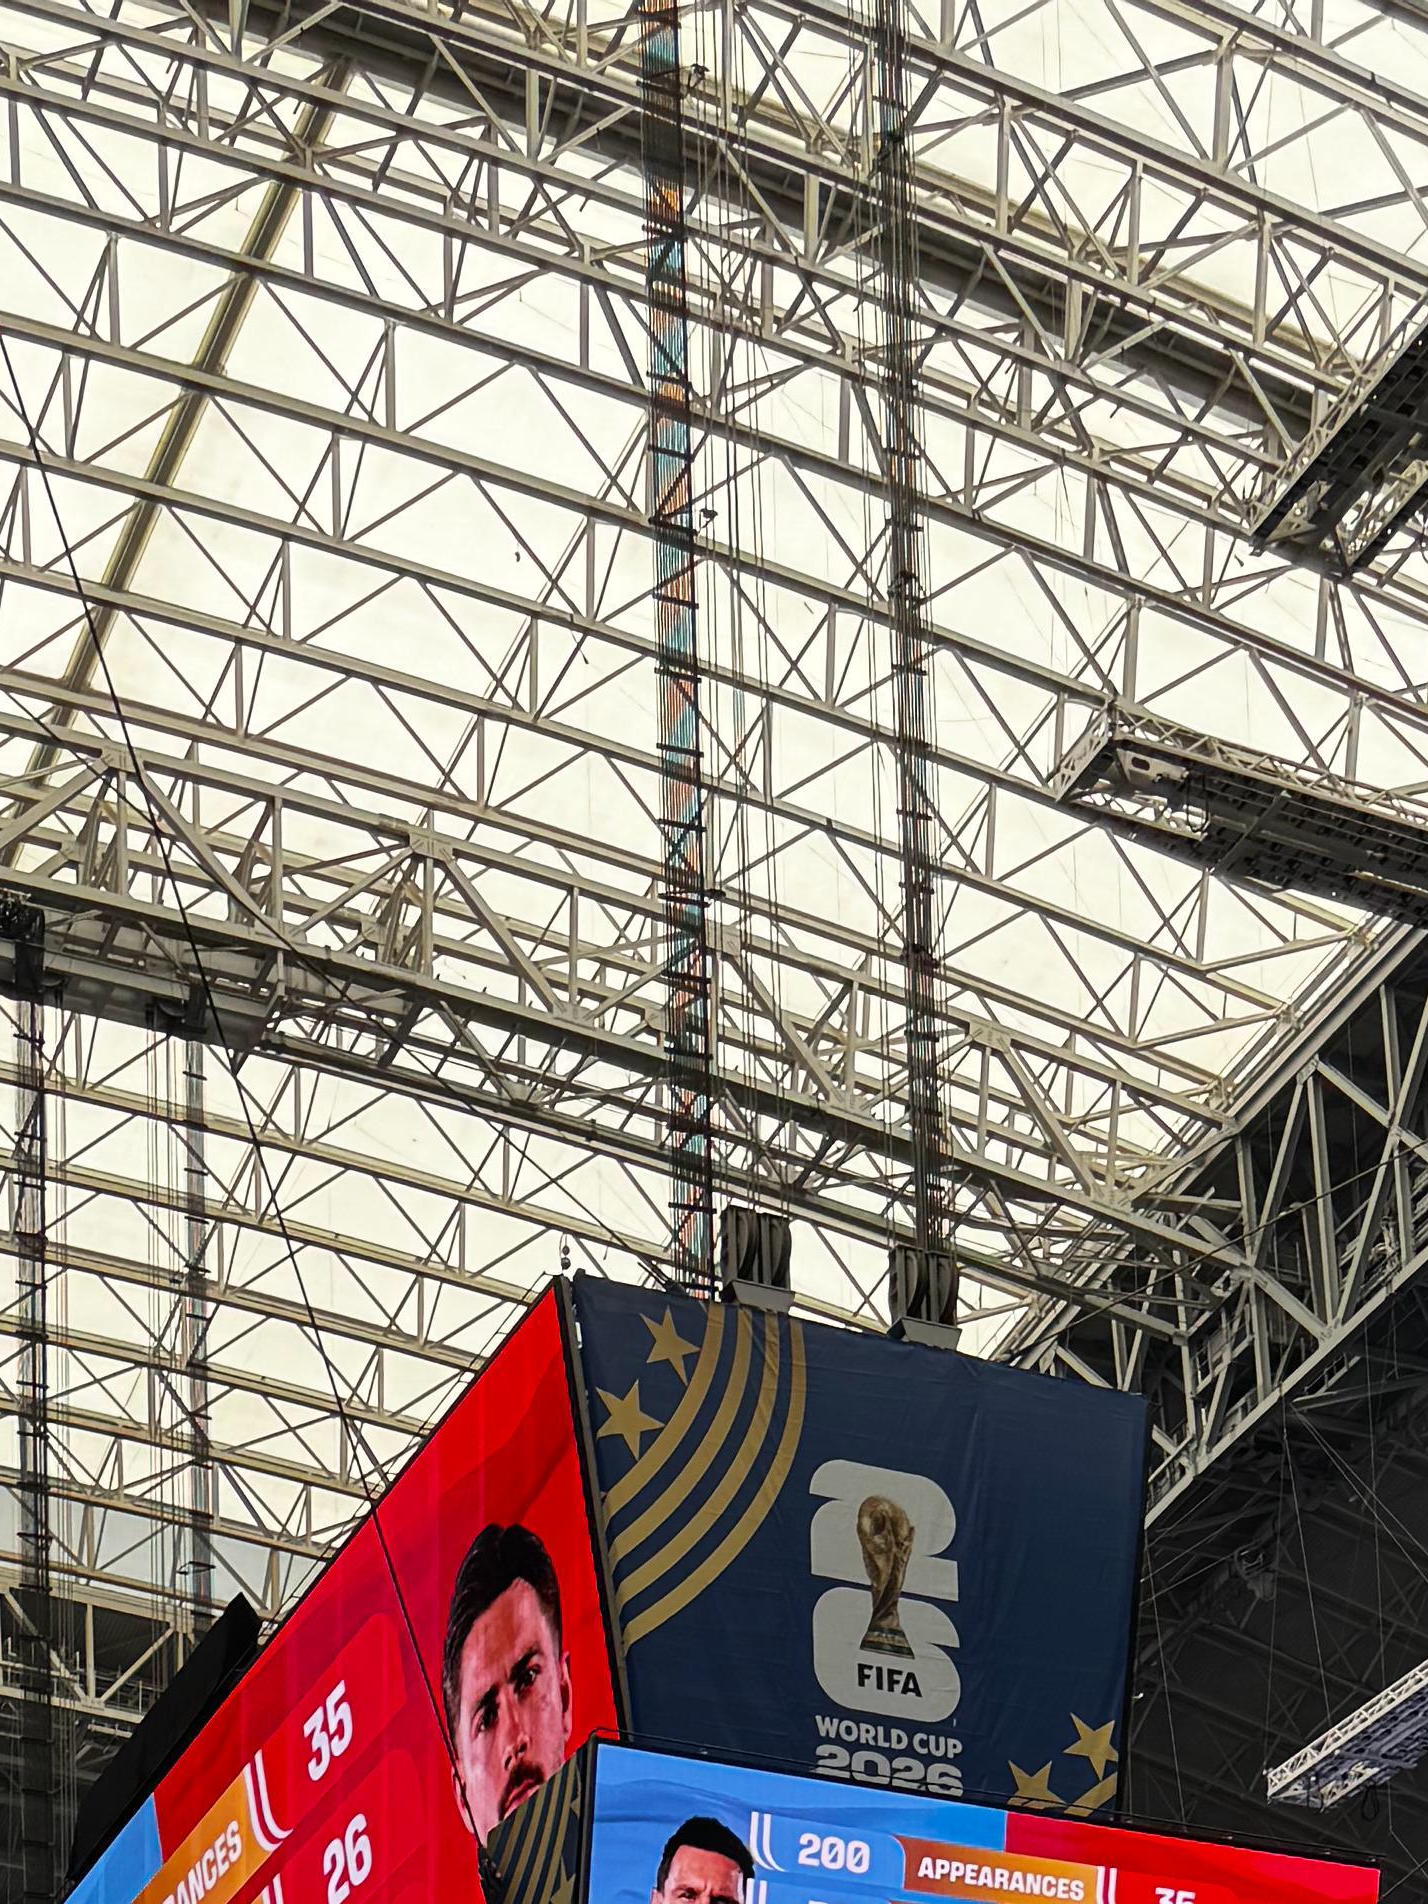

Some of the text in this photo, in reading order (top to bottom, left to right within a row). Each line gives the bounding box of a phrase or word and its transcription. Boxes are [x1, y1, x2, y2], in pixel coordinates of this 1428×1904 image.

[857, 1662, 923, 1698] FIFA
[303, 1680, 353, 1781] 35
[815, 1714, 963, 1759] WORLD CUP
[813, 1744, 964, 1797] 2026
[797, 1833, 871, 1874] 200
[918, 1857, 1085, 1900] APPEARANCES
